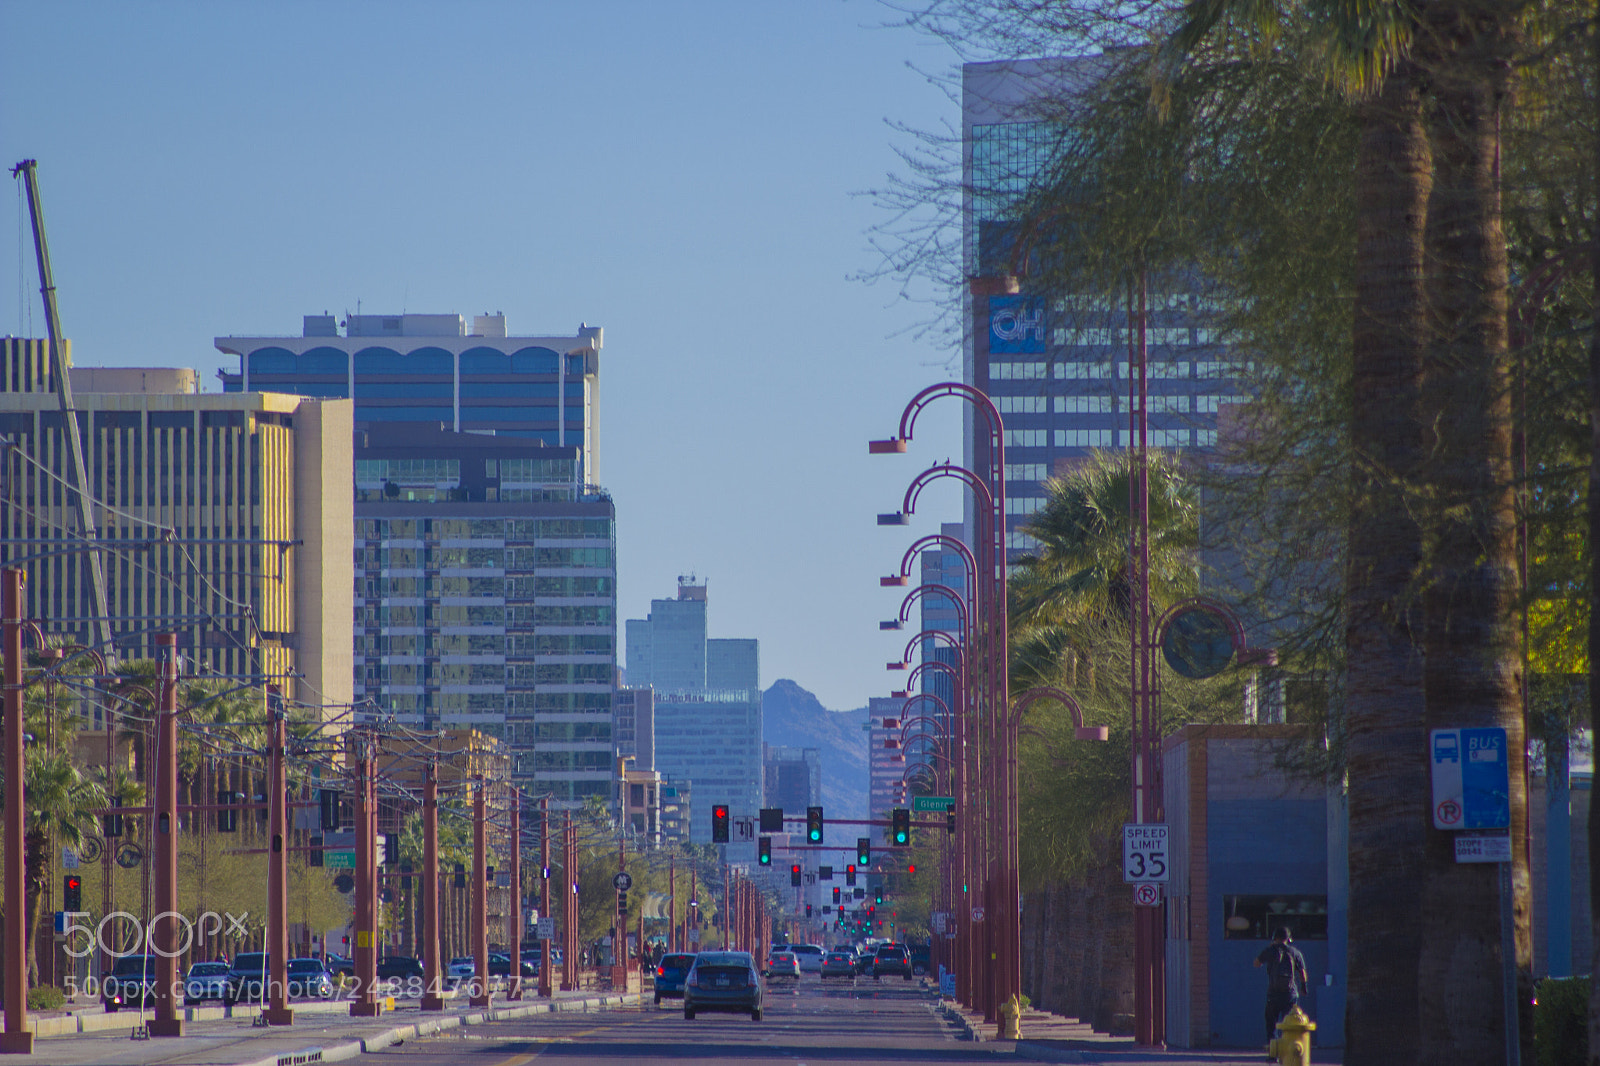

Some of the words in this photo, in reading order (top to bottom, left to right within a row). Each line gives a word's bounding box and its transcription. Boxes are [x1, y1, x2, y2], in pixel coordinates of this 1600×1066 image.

[1469, 736, 1501, 750] BUS
[1127, 828, 1167, 838] SPEED
[1131, 840, 1162, 850] LIMIT
[1128, 852, 1166, 877] 35
